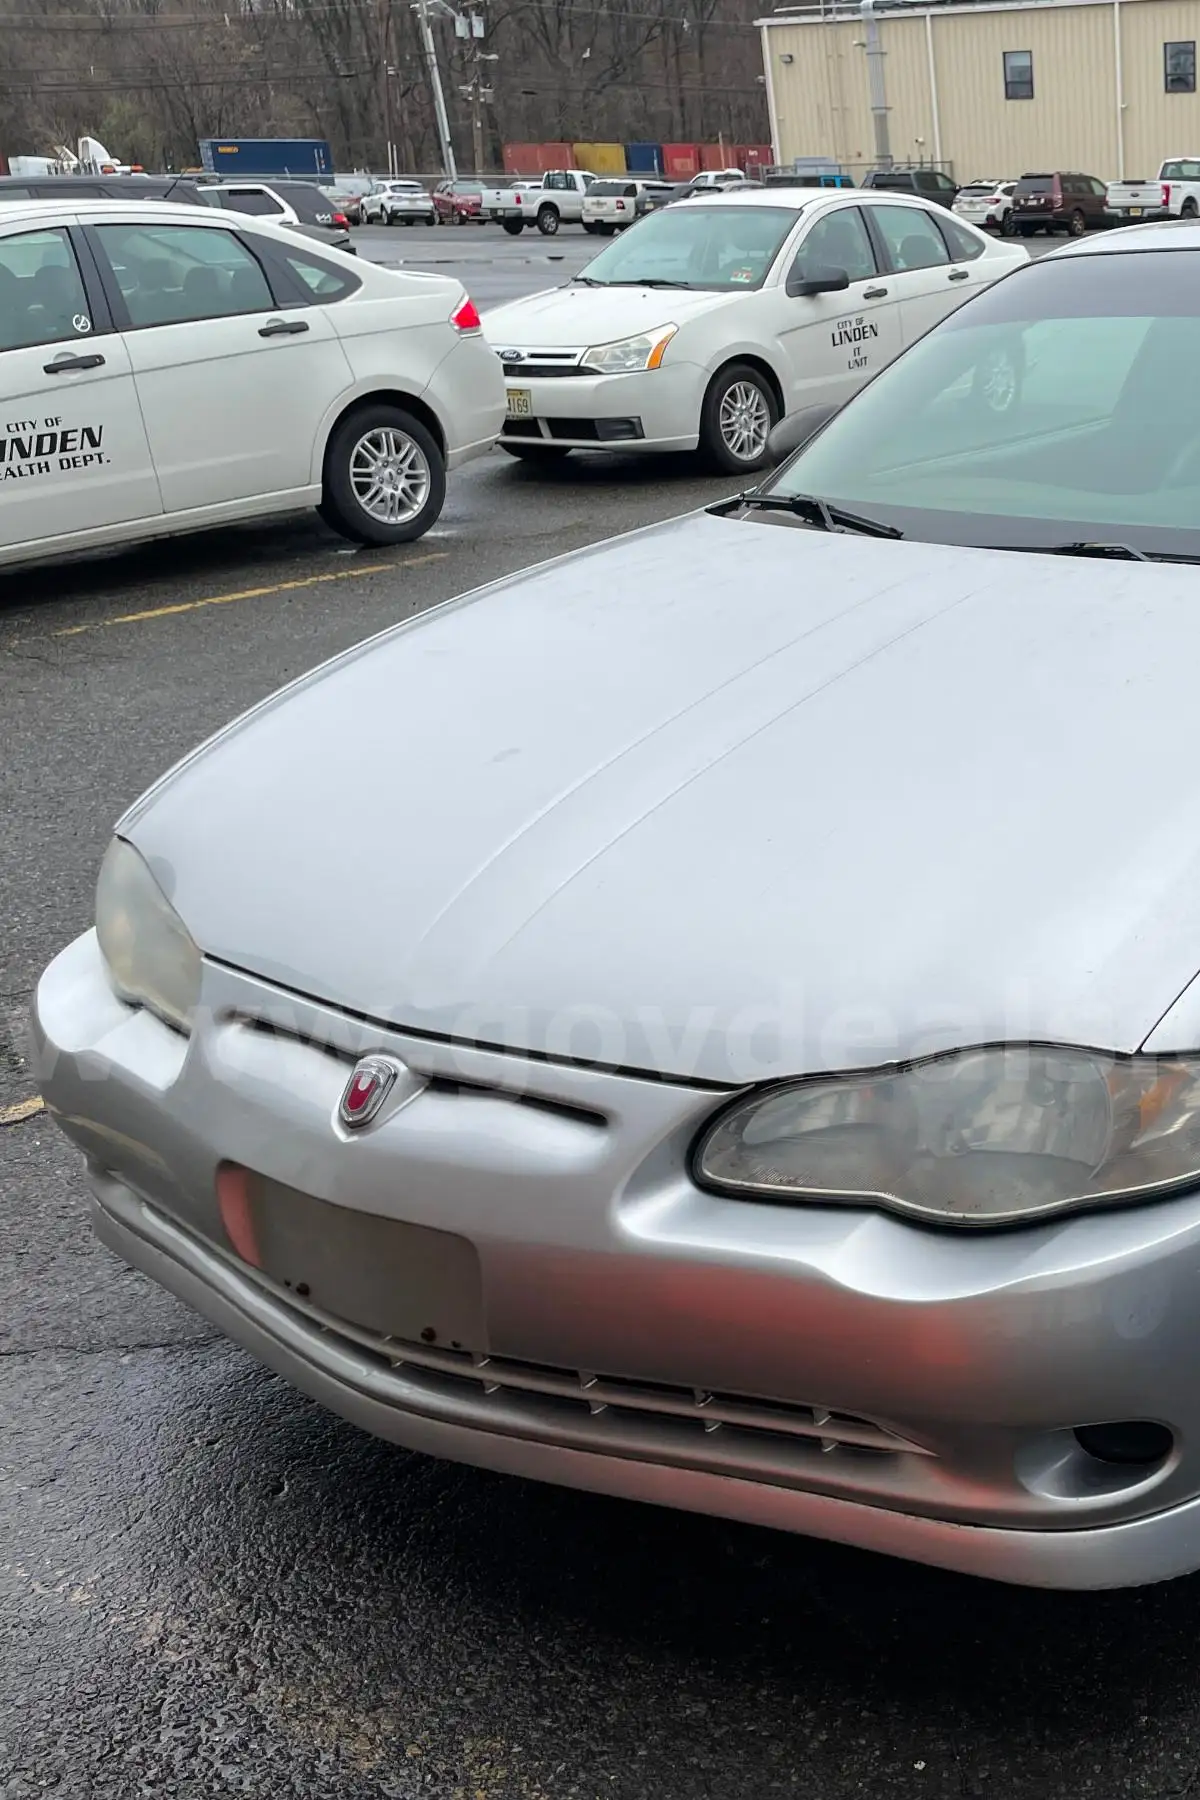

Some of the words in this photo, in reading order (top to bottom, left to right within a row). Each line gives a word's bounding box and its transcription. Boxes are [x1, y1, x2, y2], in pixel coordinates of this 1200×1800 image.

[837, 320, 852, 330] CITY
[832, 323, 878, 347] LINDEN
[853, 346, 861, 357] IT
[848, 356, 868, 370] UNIT
[6, 420, 37, 433] CITY
[45, 416, 62, 428] OF
[0, 461, 50, 480] ALTH
[59, 452, 111, 471] DEPT.
